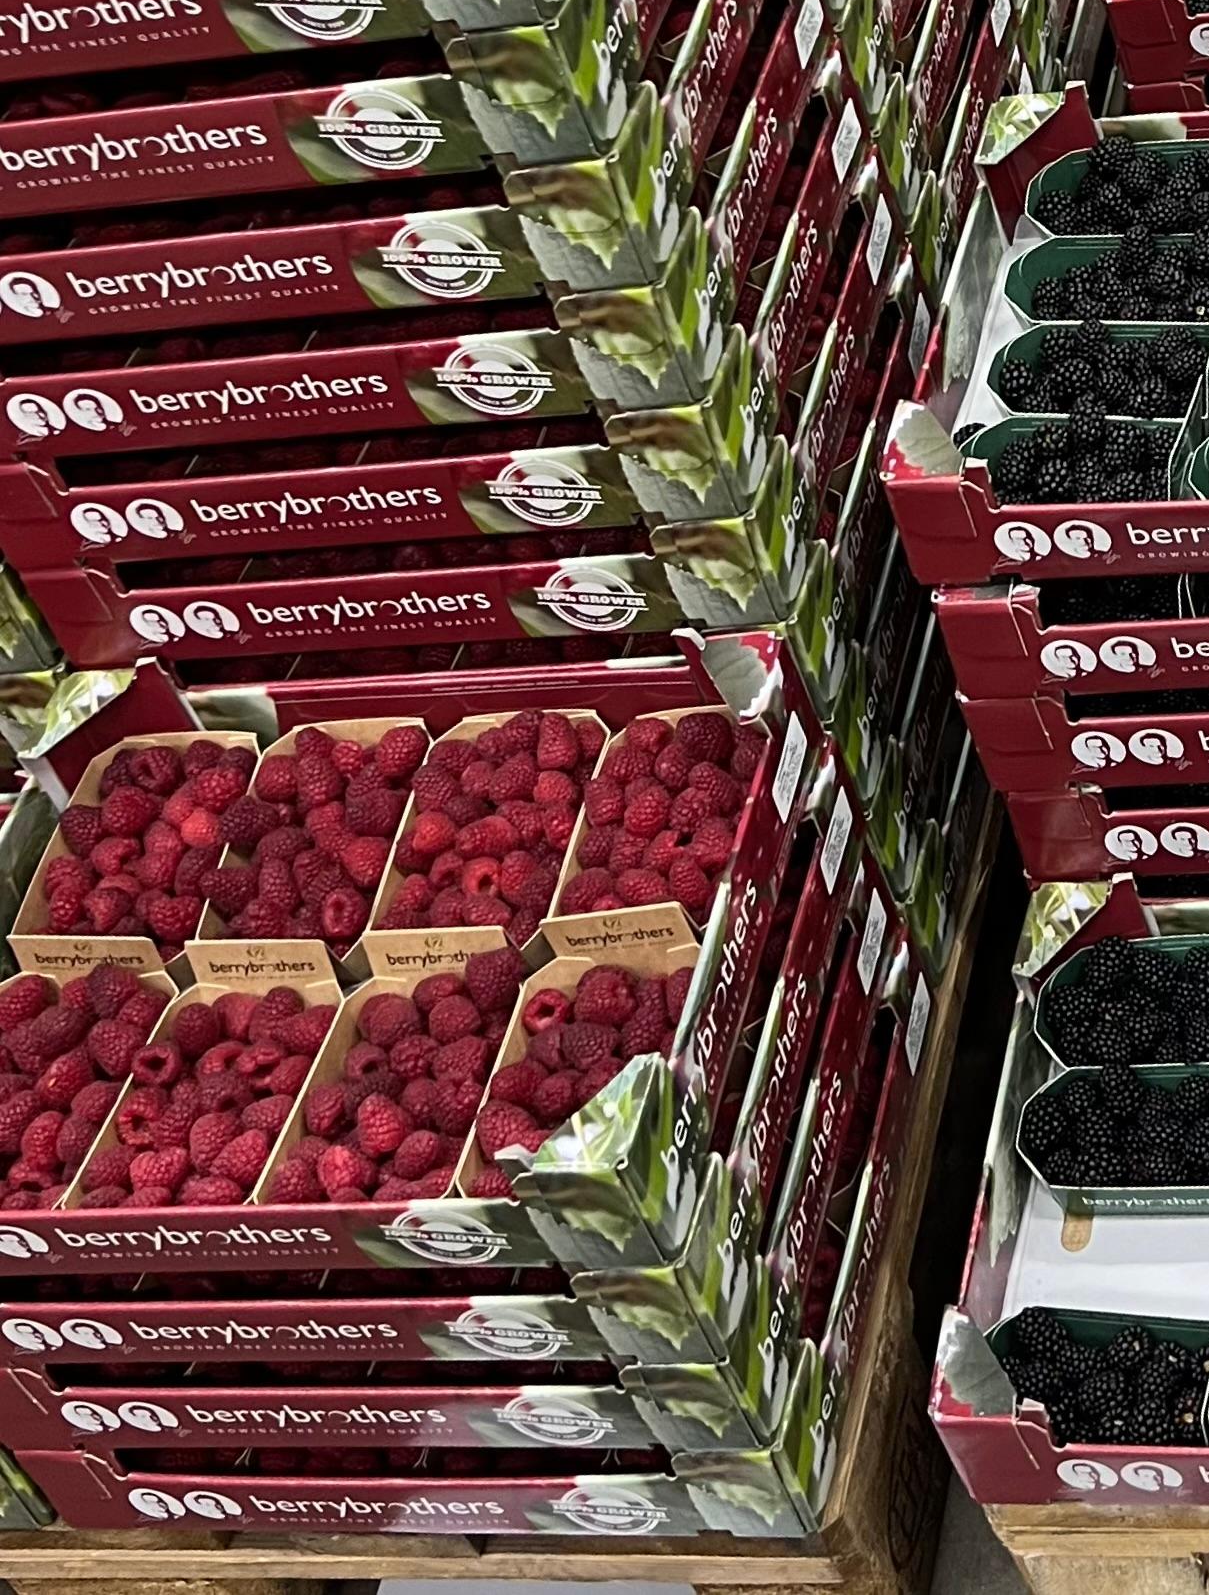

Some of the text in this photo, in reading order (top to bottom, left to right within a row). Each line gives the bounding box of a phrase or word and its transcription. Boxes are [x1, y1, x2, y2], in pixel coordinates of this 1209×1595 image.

[363, 125, 444, 137] GROWER
[425, 255, 504, 268] GROWER
[68, 254, 332, 297] berrybrothers
[478, 375, 554, 387] GROWER
[130, 374, 388, 413] berrybrothers
[529, 488, 603, 500] GROWER
[190, 486, 442, 522] berrybrothers
[245, 591, 491, 625] berrybrothers
[576, 595, 648, 607] GROWER
[566, 925, 674, 948] berrybrothers
[209, 960, 315, 975] berrybrothers
[386, 952, 475, 967] berrybroth
[56, 1225, 332, 1250] berrybrothers
[428, 1233, 511, 1246] GROWER
[128, 1320, 398, 1343] berrybrothers
[491, 1329, 571, 1342] GROWER
[187, 1405, 447, 1427] berrybrothers
[247, 1496, 504, 1517] berrybrothers
